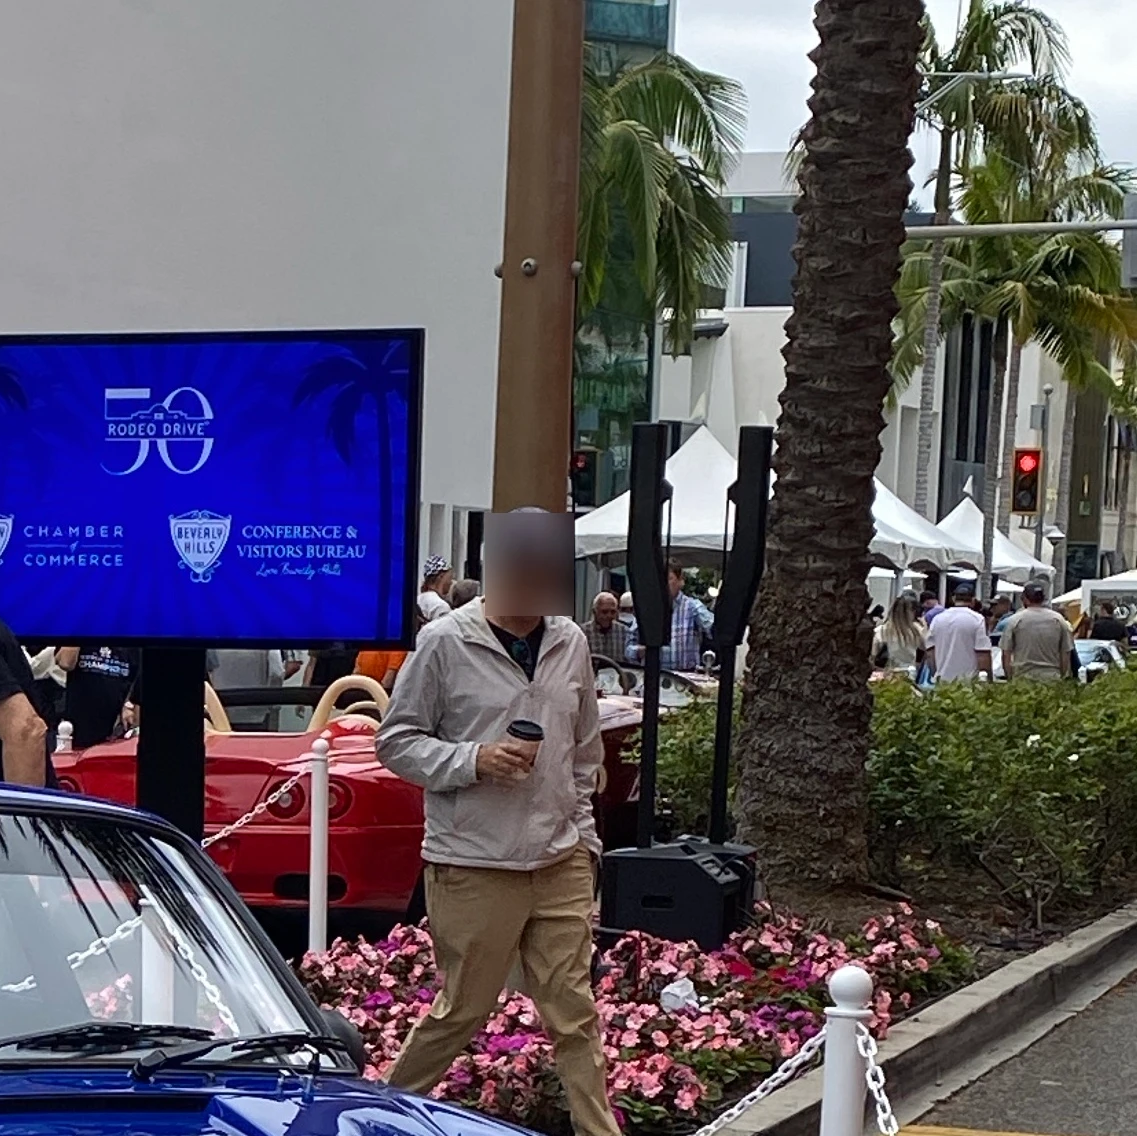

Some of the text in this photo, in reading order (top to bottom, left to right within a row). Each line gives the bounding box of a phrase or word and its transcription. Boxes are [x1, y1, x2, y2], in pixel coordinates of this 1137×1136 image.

[100, 386, 214, 475] 50
[108, 422, 206, 436] RODEO DRIVE
[23, 525, 124, 538] CHAMBER
[177, 526, 223, 540] BEVERLY
[241, 525, 358, 539] CONFERENCE &
[184, 541, 216, 555] HILLS
[236, 544, 367, 559] VISITORS BUREAU
[23, 554, 124, 567] COMMERCE
